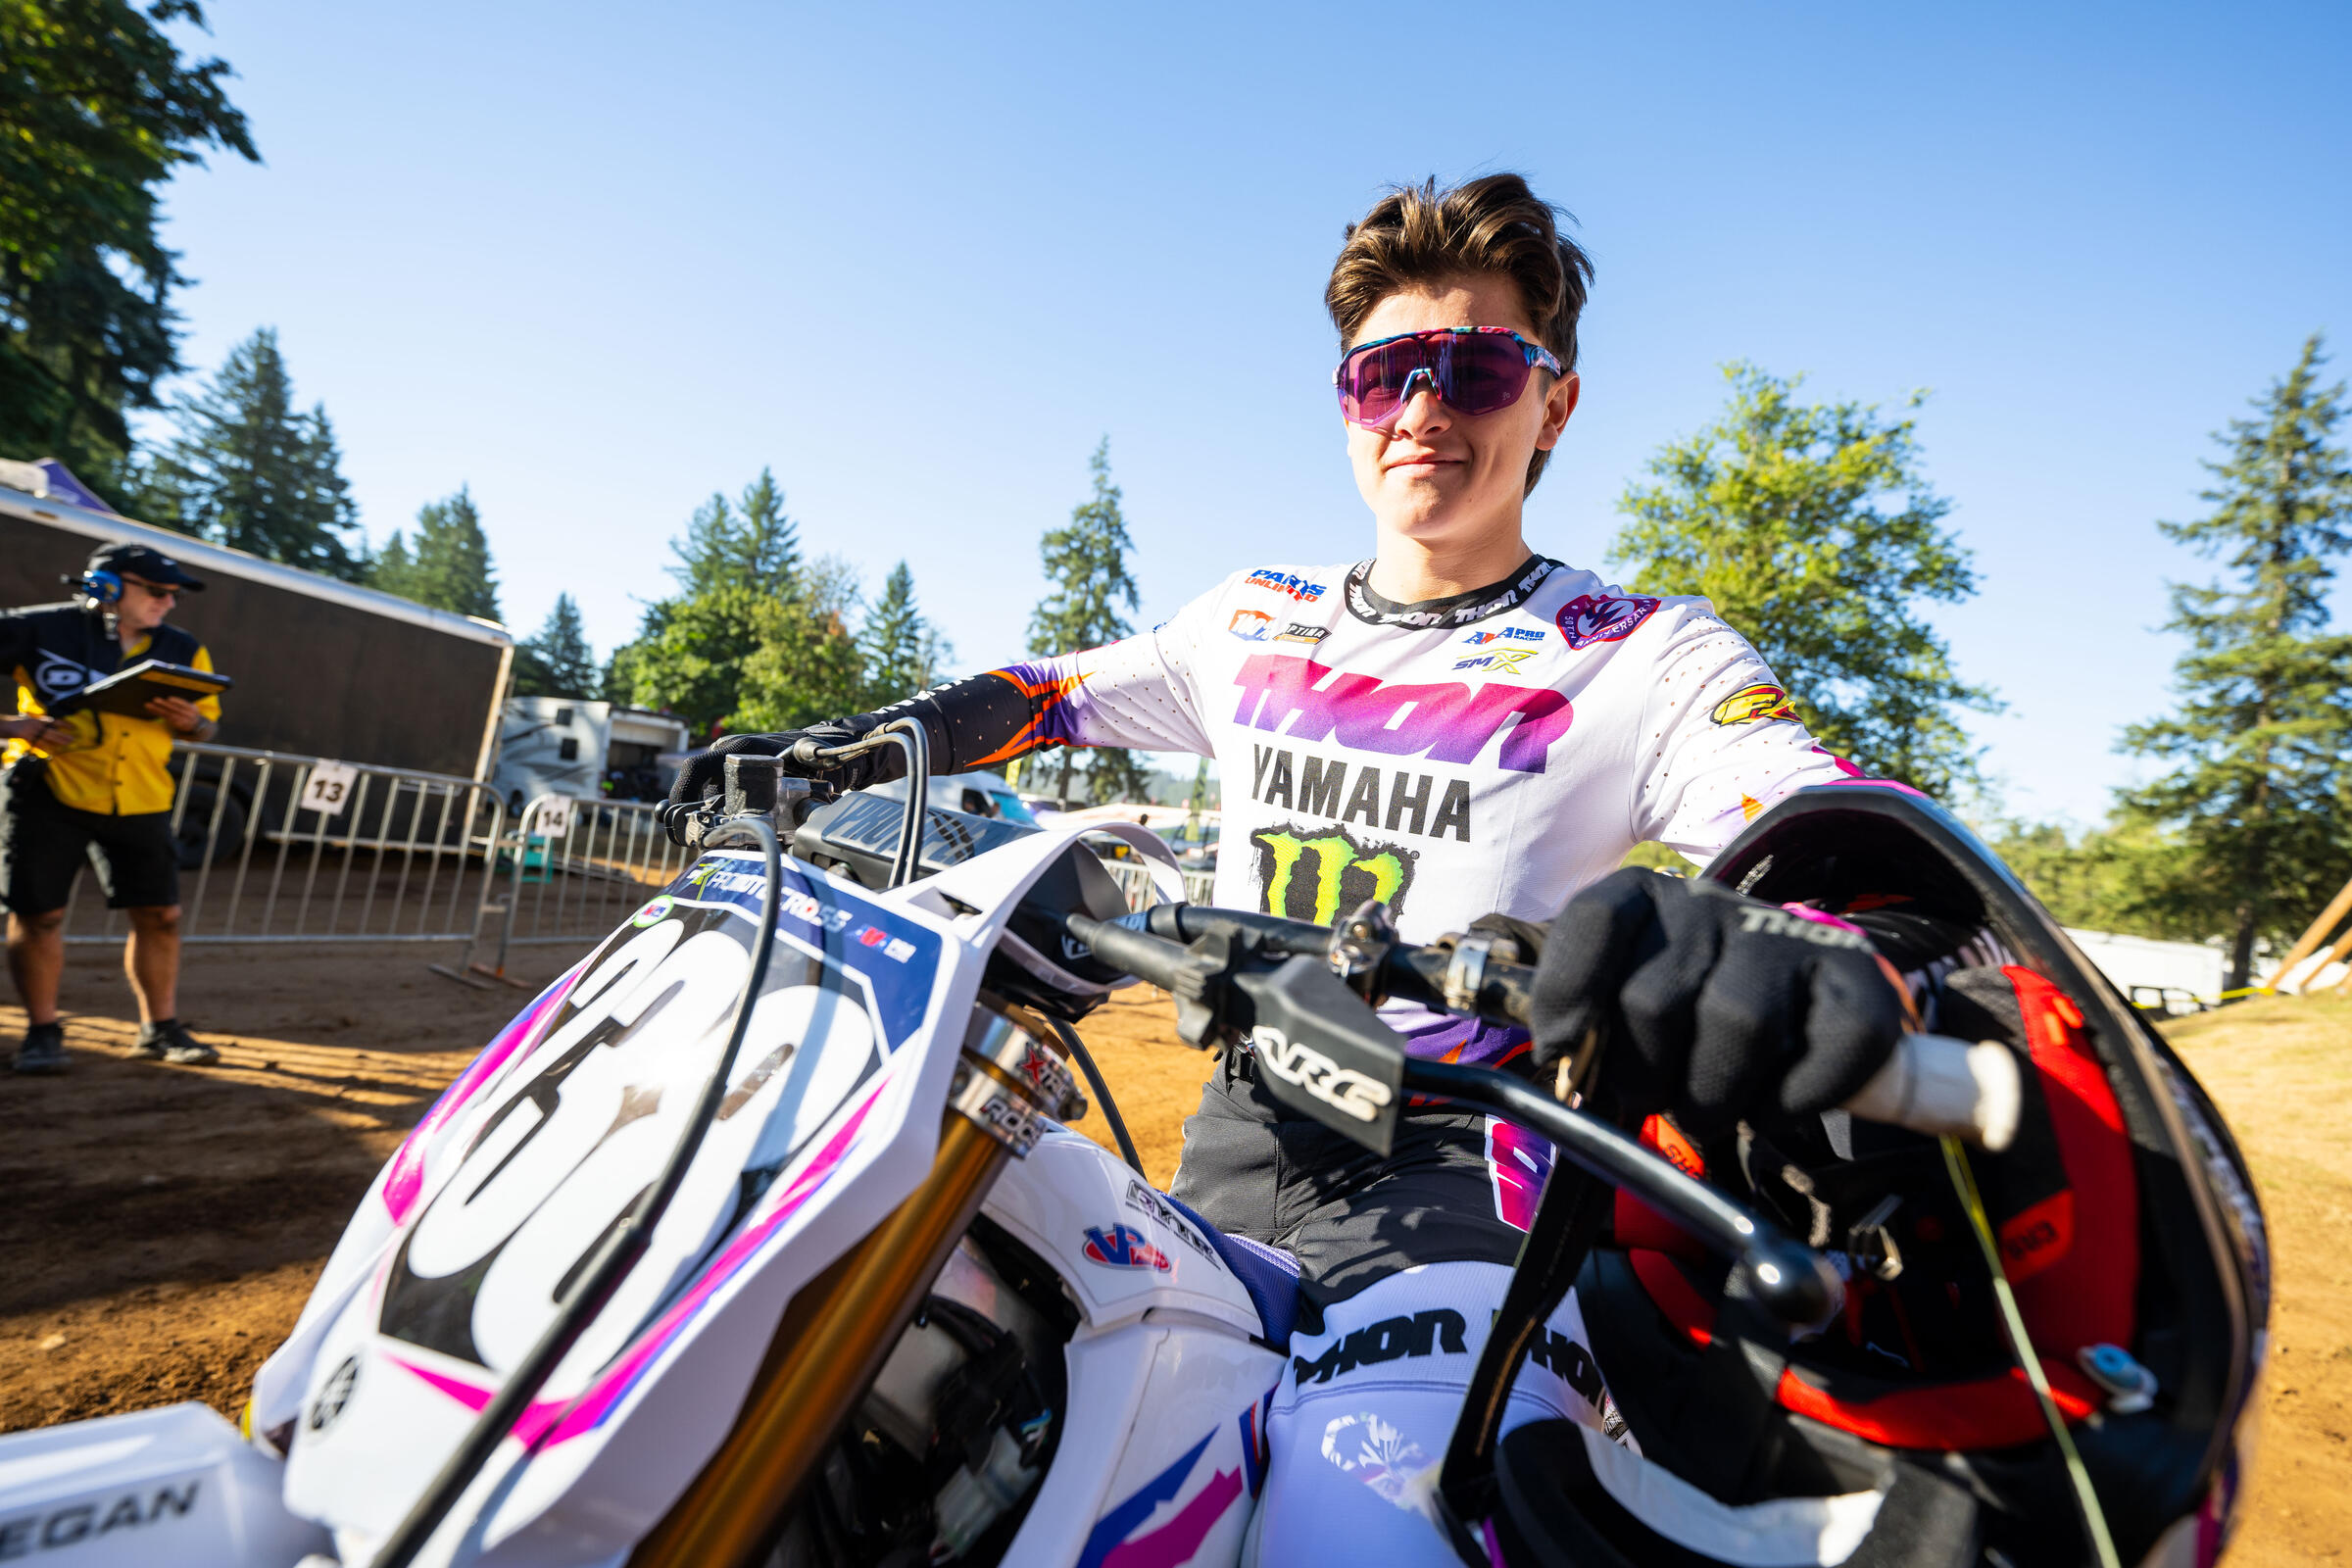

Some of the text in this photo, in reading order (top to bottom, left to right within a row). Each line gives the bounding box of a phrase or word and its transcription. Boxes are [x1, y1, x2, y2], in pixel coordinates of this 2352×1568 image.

[1455, 590, 1518, 623] THOR
[1286, 624, 1327, 639] PTIMA
[1516, 629, 1545, 638] PRO
[1564, 615, 1577, 639] 50TH
[1451, 649, 1536, 675] SMX
[1233, 654, 1574, 774] THOR
[315, 779, 345, 802] 13
[1251, 744, 1471, 843] YAMAHA
[543, 811, 564, 827] 14
[1084, 1223, 1147, 1265] VP
[1294, 1308, 1468, 1392] THOR
